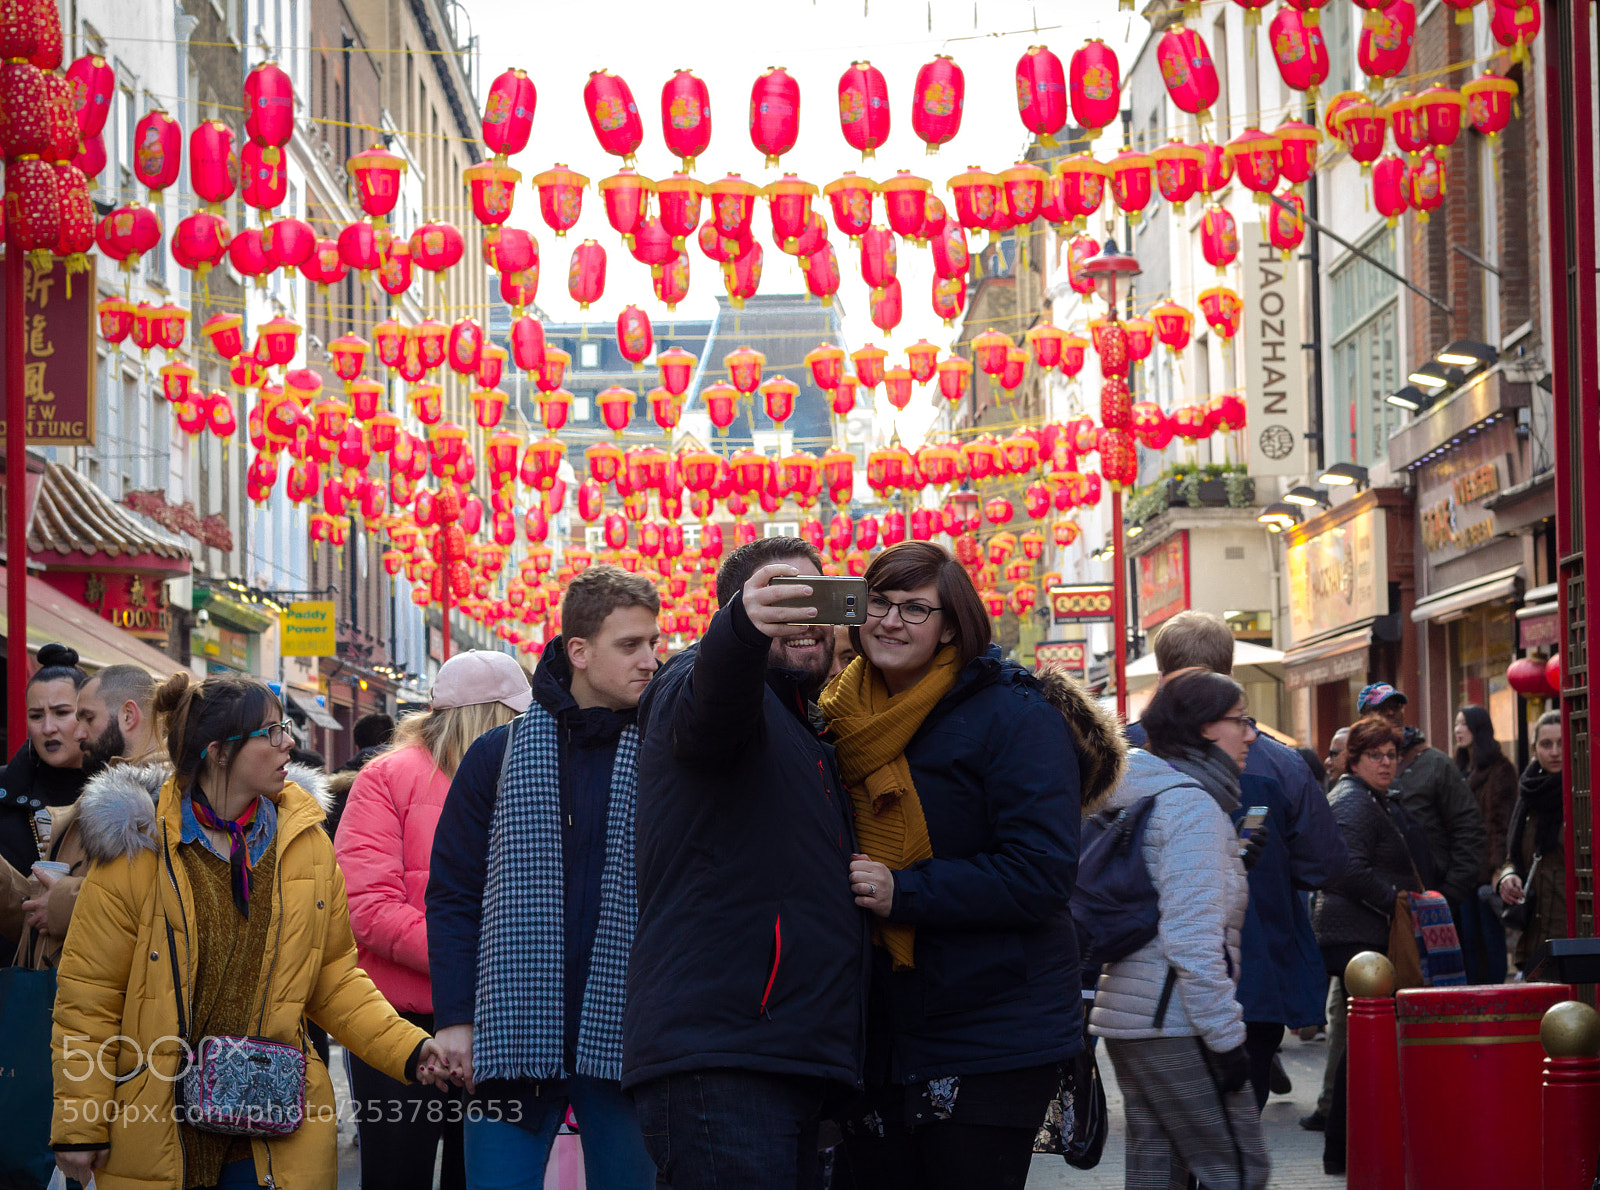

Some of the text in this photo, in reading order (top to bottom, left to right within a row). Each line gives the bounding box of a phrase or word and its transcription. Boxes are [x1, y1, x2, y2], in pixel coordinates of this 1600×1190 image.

[1259, 242, 1287, 414] HAOZHAN
[27, 404, 56, 421] EW
[37, 421, 84, 437] FUNG
[286, 609, 327, 621] Paddy
[286, 624, 328, 634] Power
